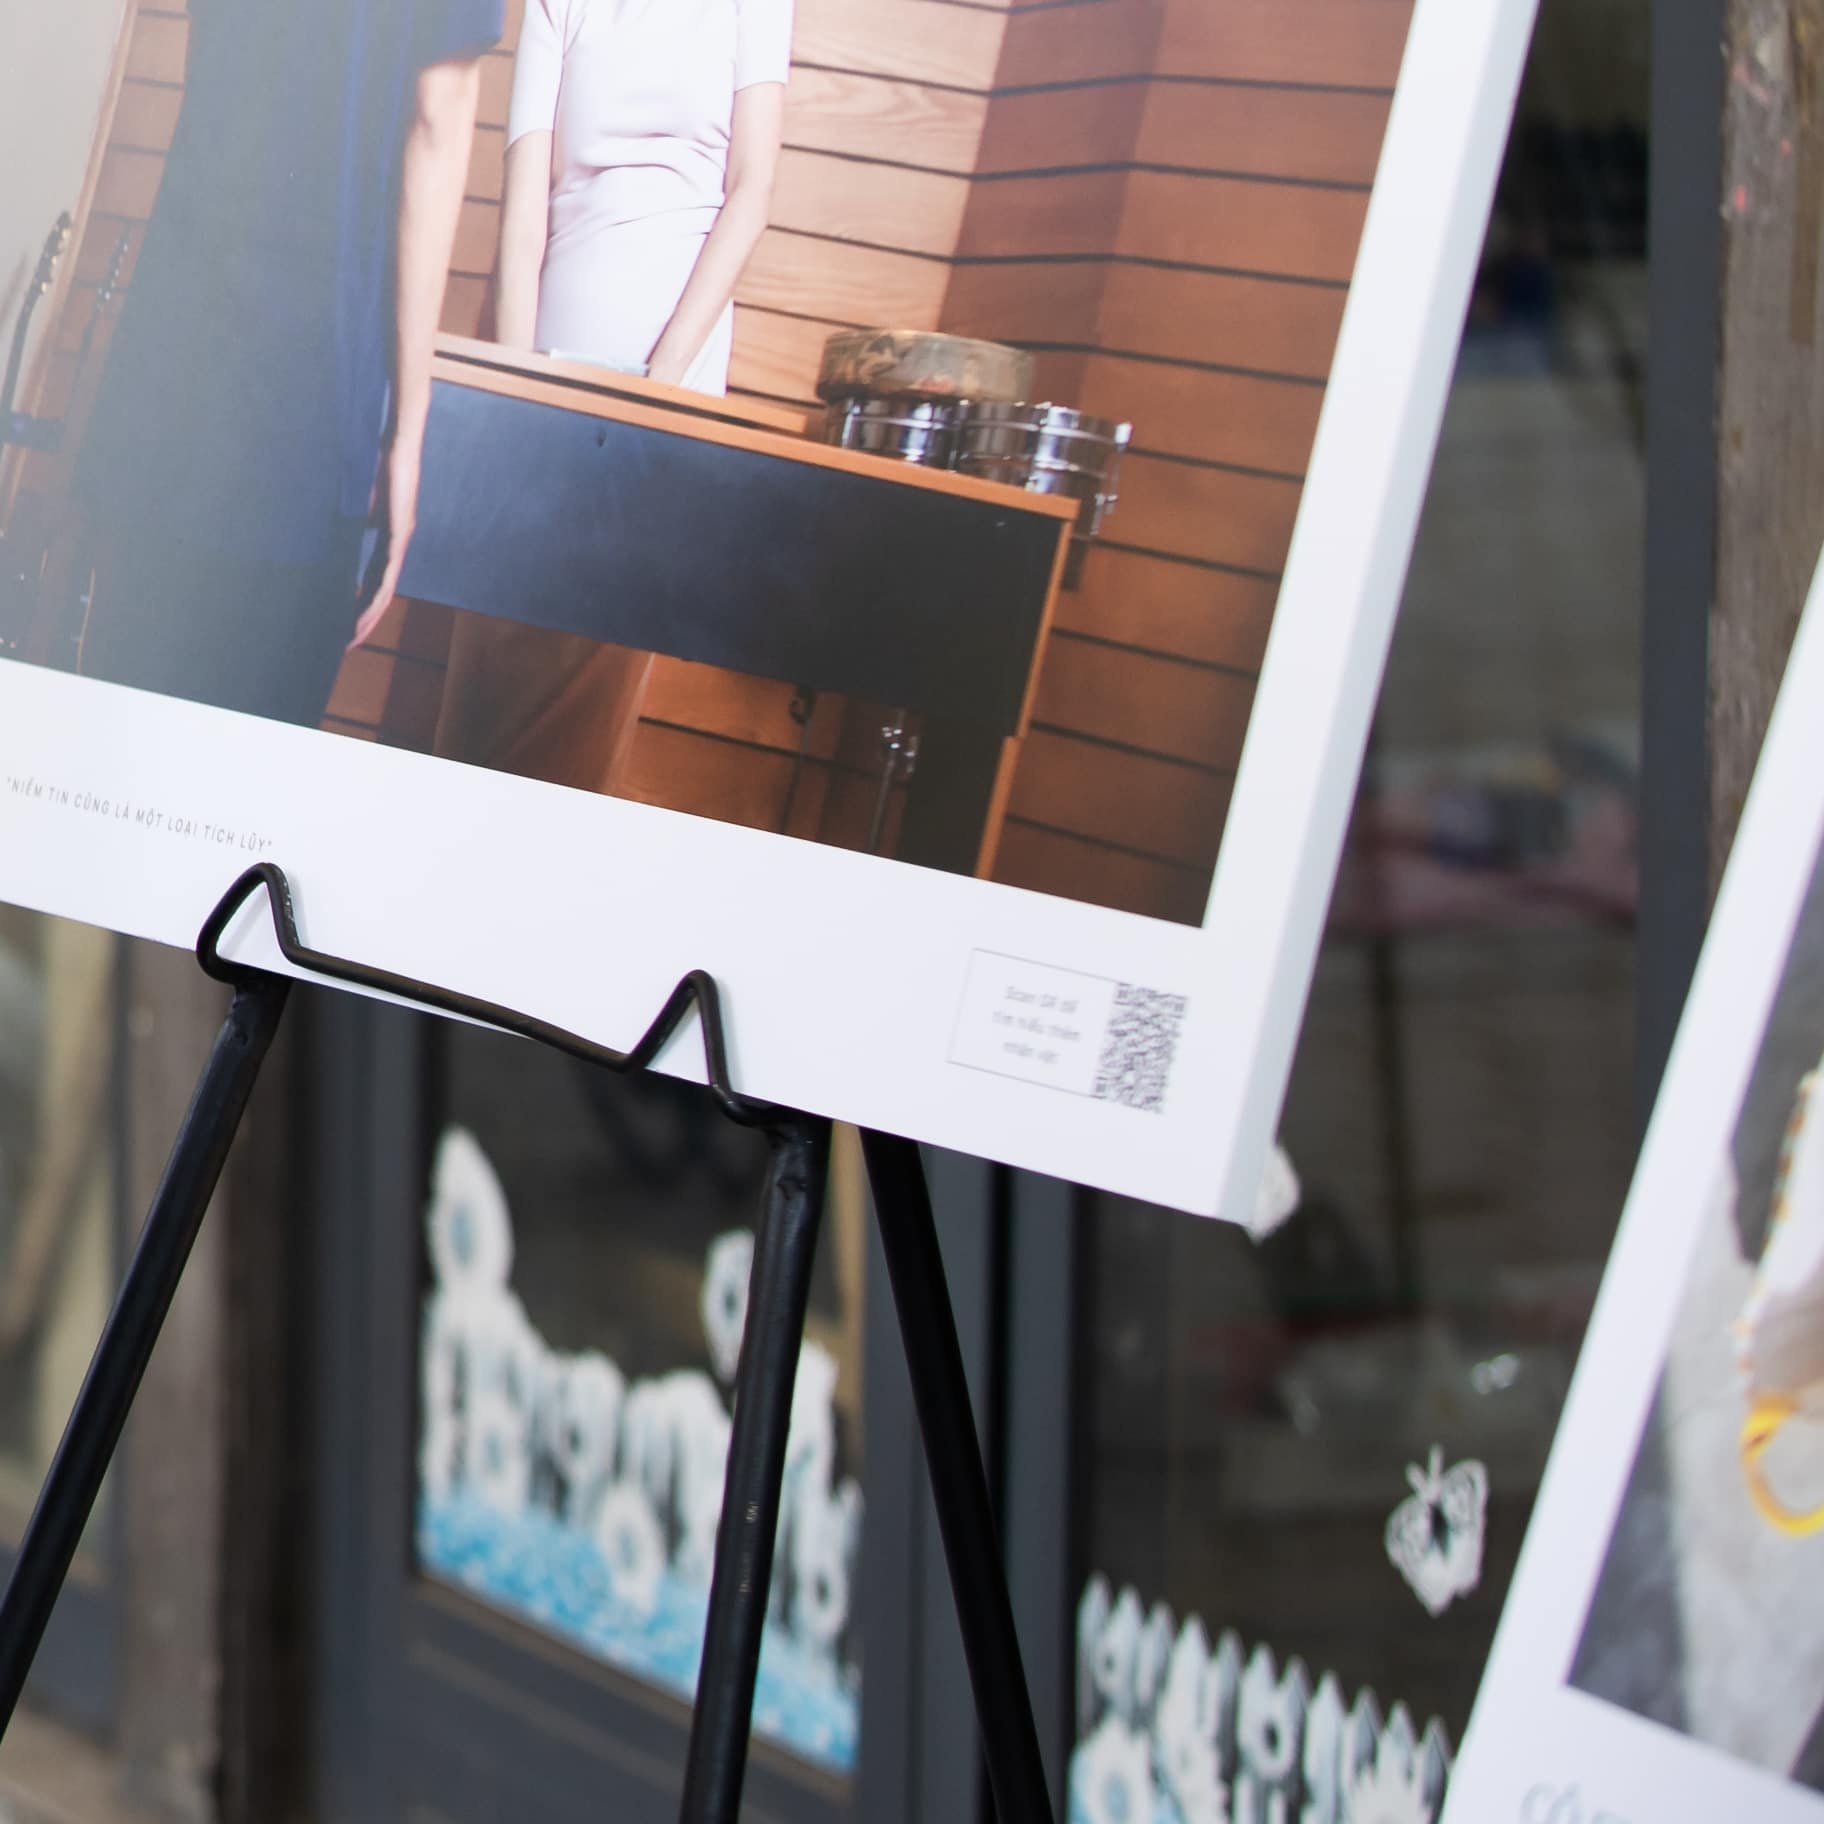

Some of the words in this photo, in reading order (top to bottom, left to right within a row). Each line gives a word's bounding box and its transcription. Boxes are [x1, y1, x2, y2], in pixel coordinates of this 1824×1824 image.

[48, 787, 69, 806] TIN
[74, 792, 110, 815] CŨNG
[136, 808, 163, 831] MỘT
[167, 818, 198, 840] LOẠI
[204, 823, 235, 845] TÍCH
